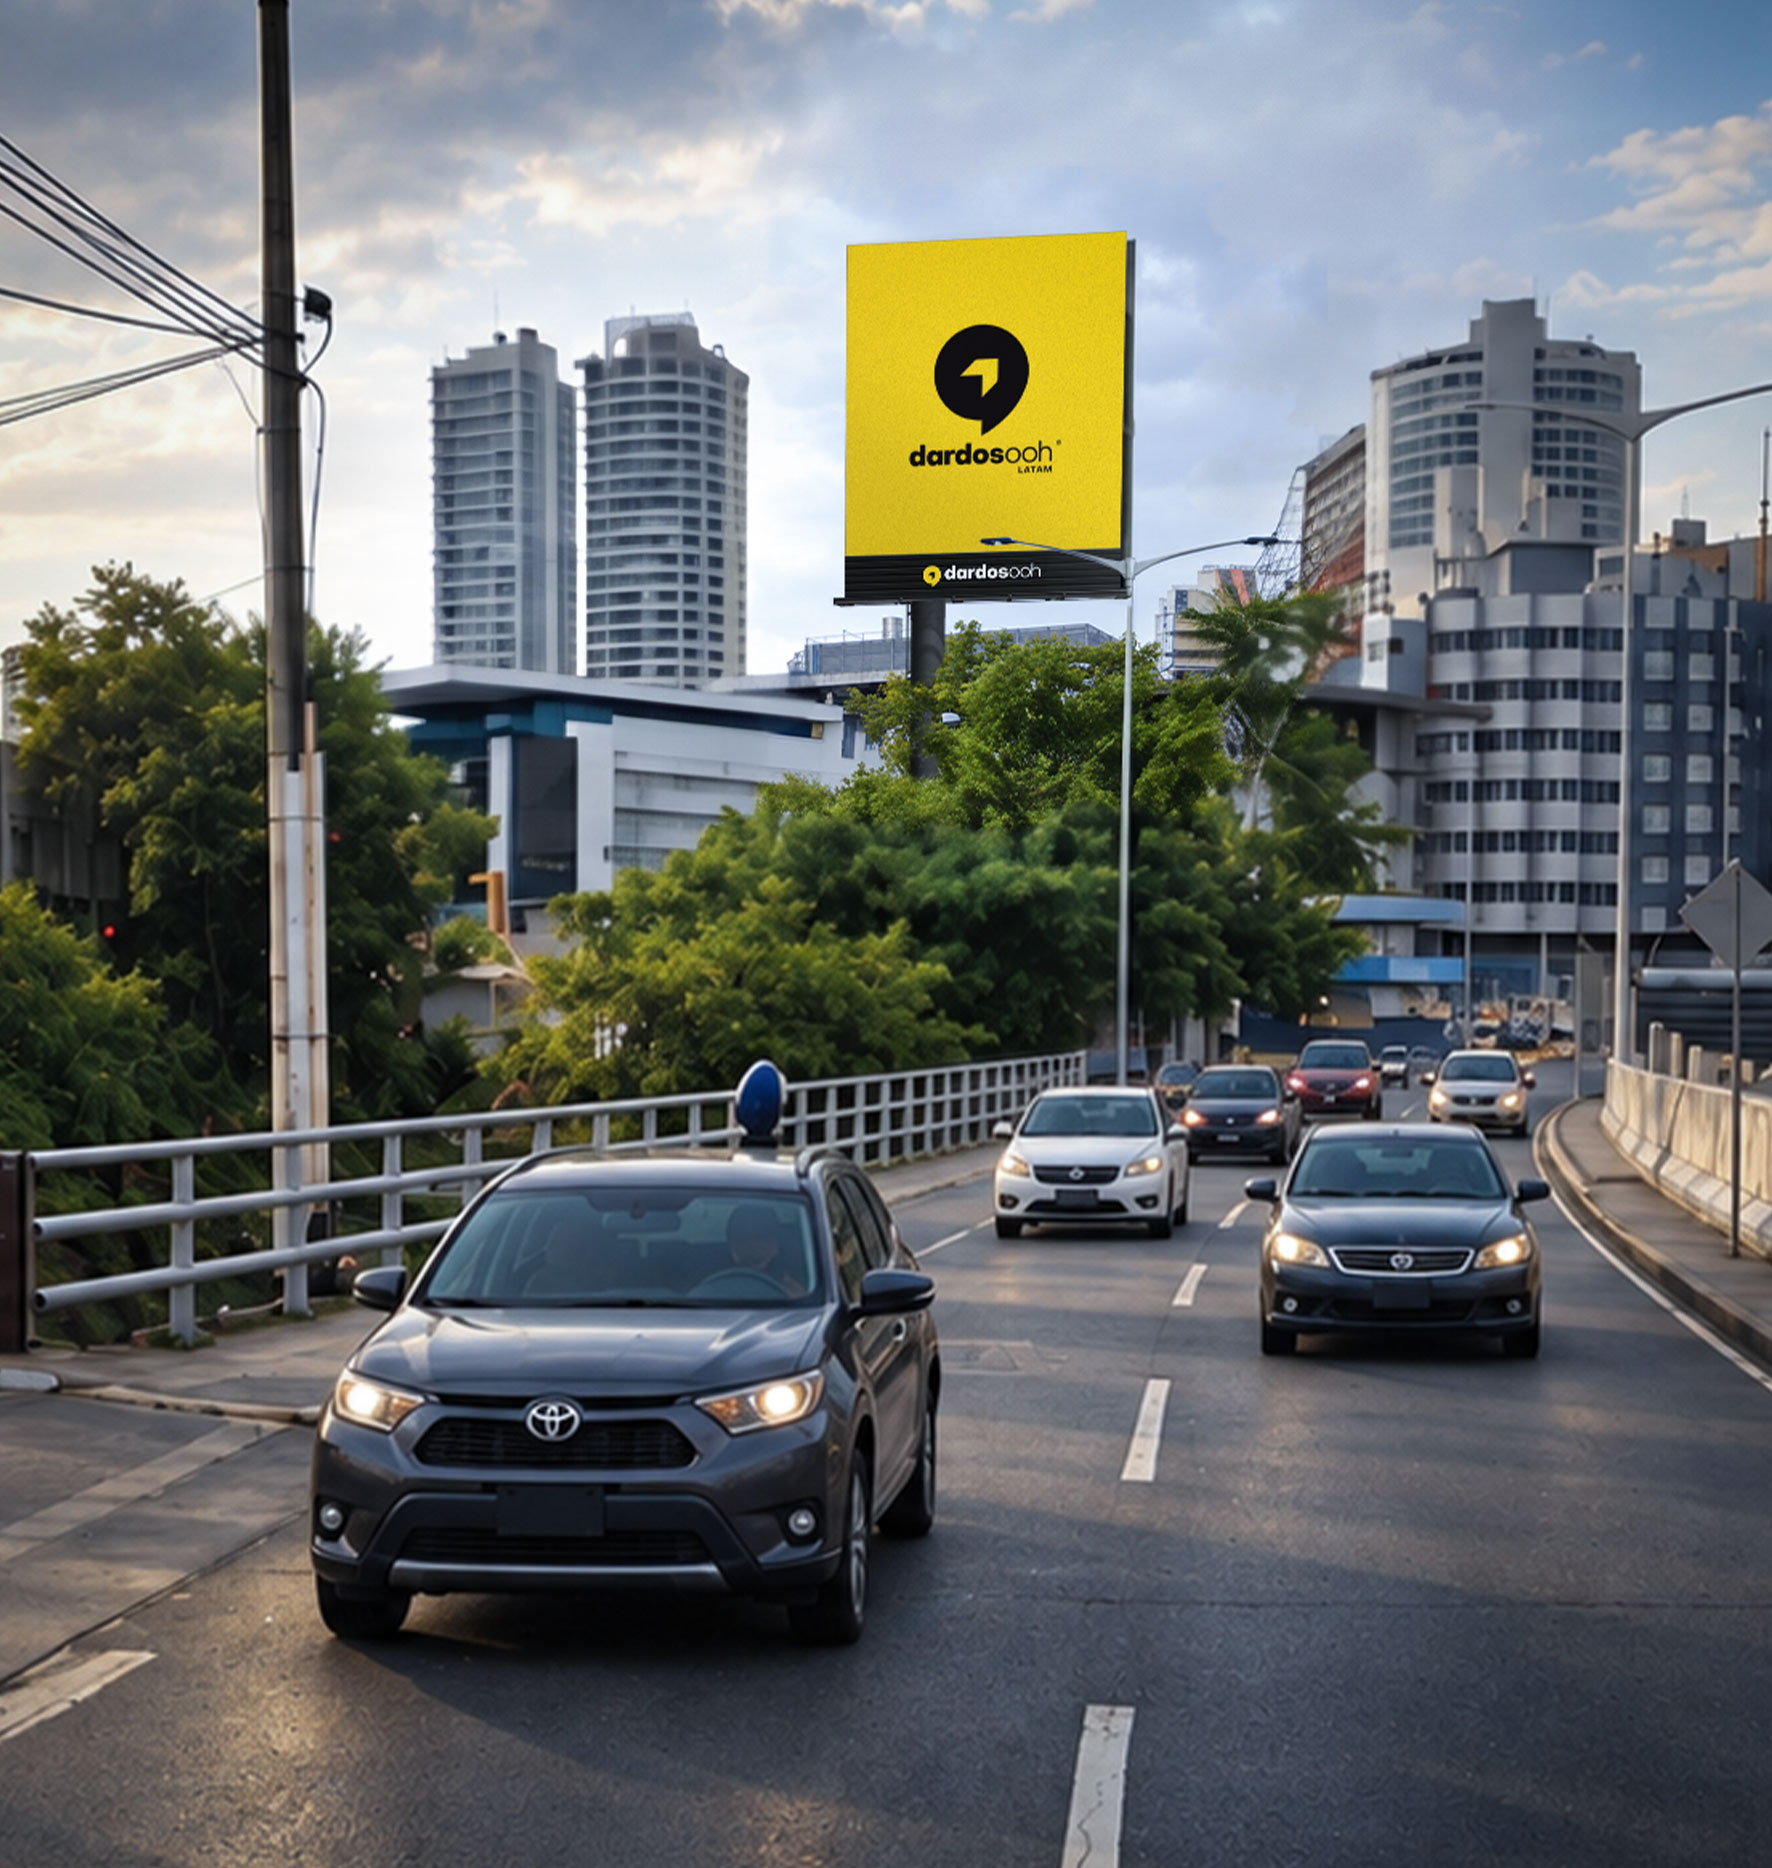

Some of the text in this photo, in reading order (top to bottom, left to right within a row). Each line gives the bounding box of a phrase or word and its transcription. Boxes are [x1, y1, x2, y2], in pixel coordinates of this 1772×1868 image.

[908, 440, 1053, 467] dardosooh
[1017, 465, 1053, 474] LATAM
[943, 562, 1042, 581] dardosooh
